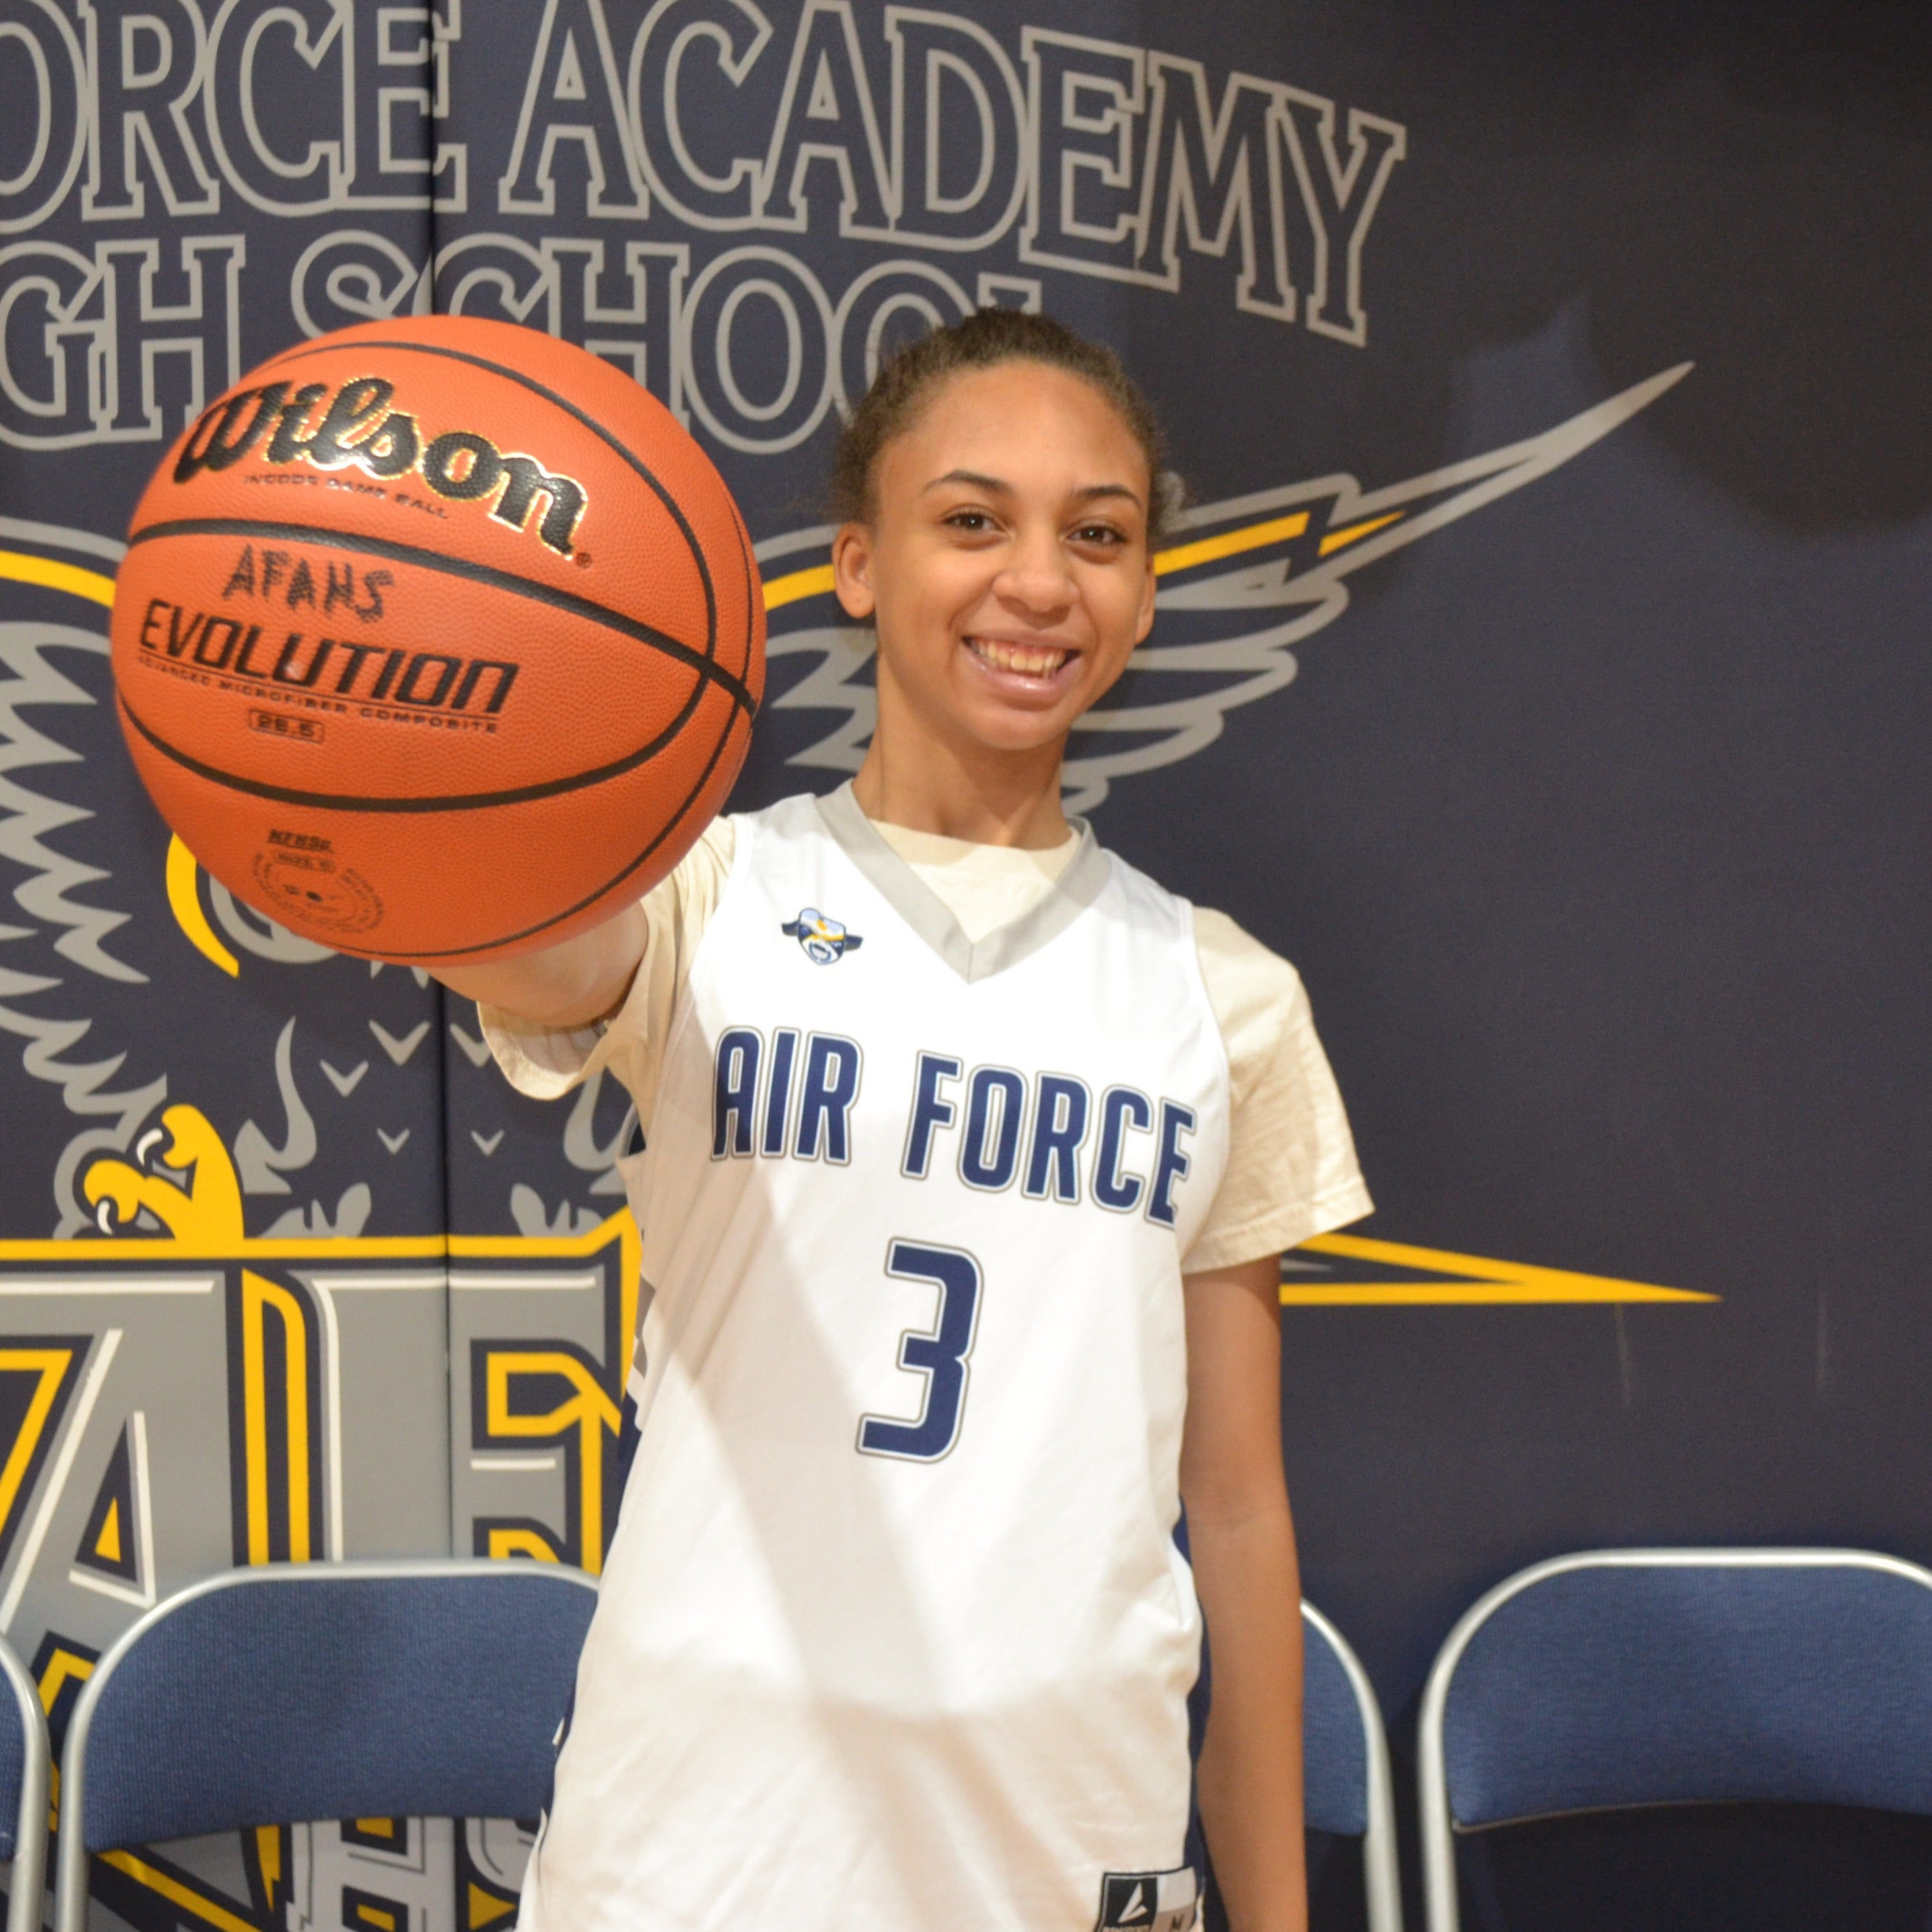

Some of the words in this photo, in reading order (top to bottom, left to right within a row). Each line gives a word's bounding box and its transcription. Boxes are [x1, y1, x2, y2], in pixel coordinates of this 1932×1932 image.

[498, 0, 1407, 347] ACADEMY
[291, 229, 1042, 454] SHOO
[173, 376, 589, 561] Wilson
[139, 598, 520, 714] EVOLUTION
[361, 706, 497, 734] COMPOSITE
[711, 1025, 864, 1166] AIR
[900, 1050, 1197, 1230] FORCE
[855, 1237, 984, 1464] 3
